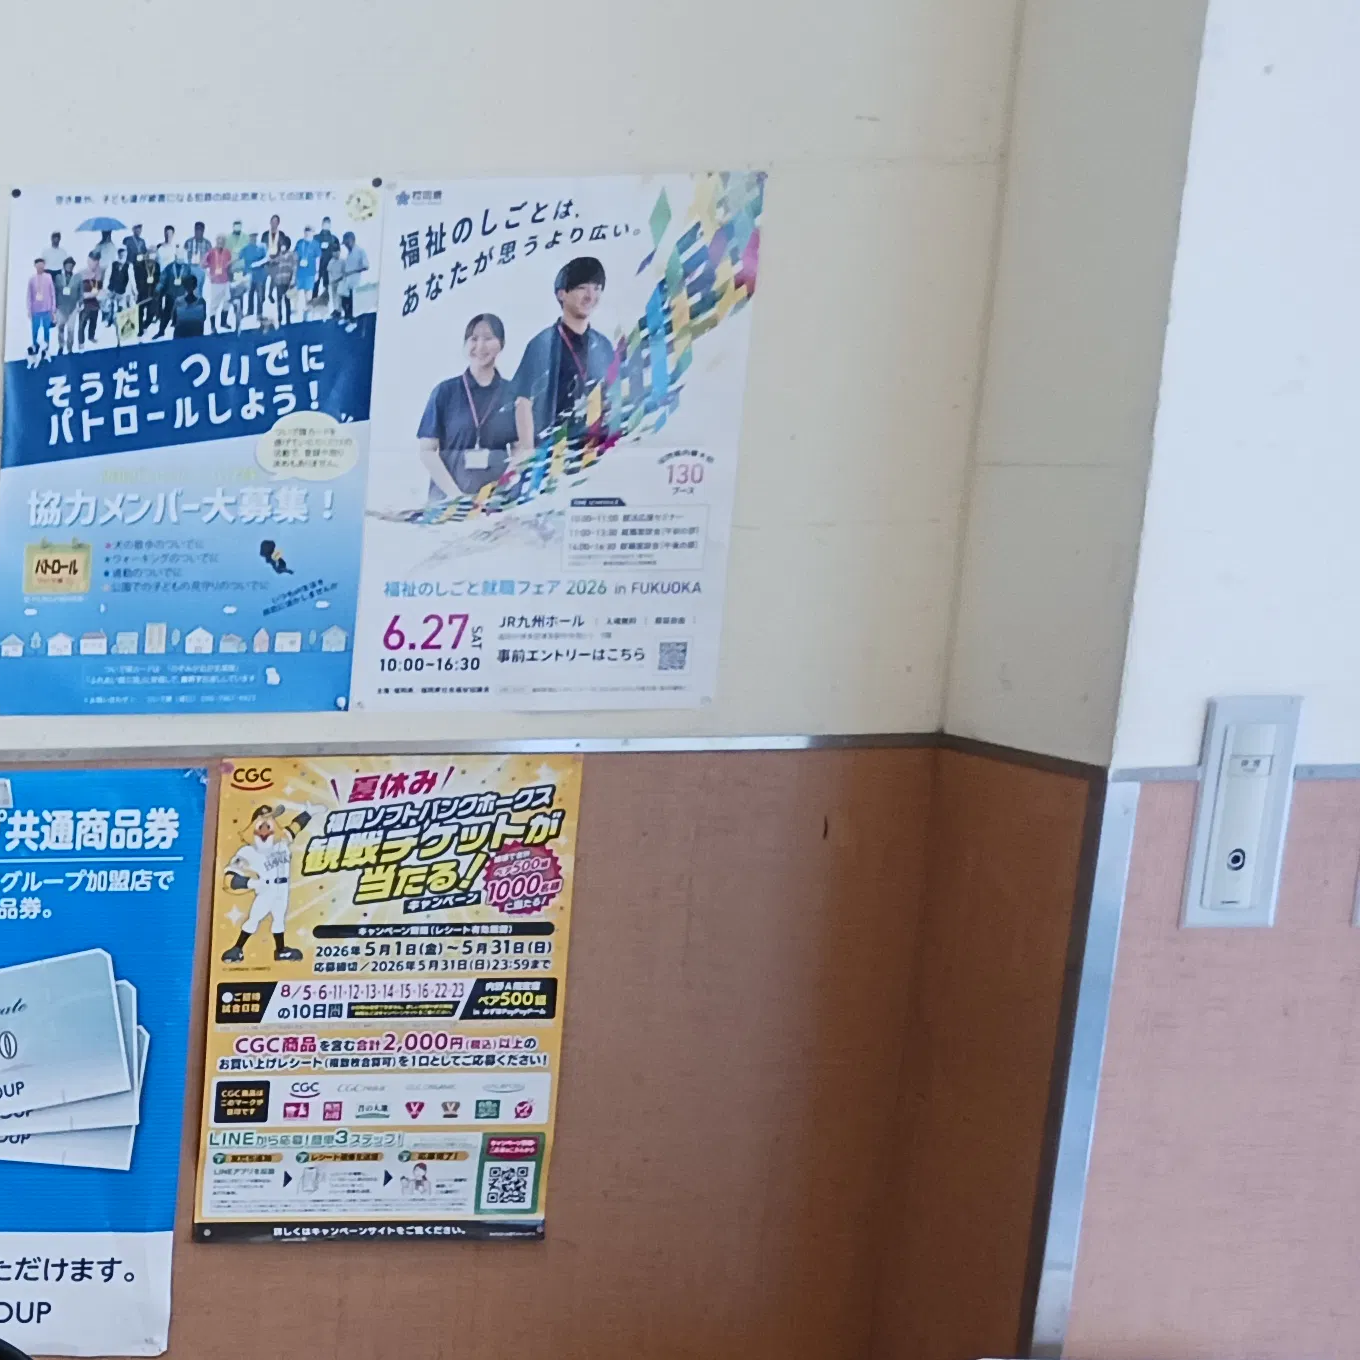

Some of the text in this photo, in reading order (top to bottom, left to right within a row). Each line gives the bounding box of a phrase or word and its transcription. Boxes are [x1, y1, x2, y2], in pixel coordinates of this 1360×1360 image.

[401, 223, 641, 318] あなたが思うより広い。
[46, 340, 326, 410] そうだ! ついでに
[48, 380, 321, 447] パトロールしよう!
[666, 464, 704, 485] 130
[27, 485, 335, 528] 協力メンバー大募集!
[35, 558, 79, 577] パトロール
[111, 553, 220, 565] ウォーキングのついでに
[383, 579, 702, 599] 福祉のしごと就職フェア 2026 in FUKUOKA
[382, 612, 470, 651] 6.27
[497, 614, 585, 629] JR九州ホール
[469, 625, 483, 650] SAT
[496, 647, 646, 664] 事前エントリーはこちら
[232, 767, 273, 784] CGC
[348, 768, 440, 803] 夏休み
[325, 785, 556, 836] 福岡ソフトバンクホークス
[302, 809, 566, 877] 観戦チケットが
[353, 851, 489, 905] 当たる!
[406, 892, 479, 913] キャンペーン
[278, 1002, 343, 1020] の10日間
[291, 1082, 320, 1094] CGC
[273, 1225, 467, 1238] 詳しくはキャンペーンサイトをご覧ください。
